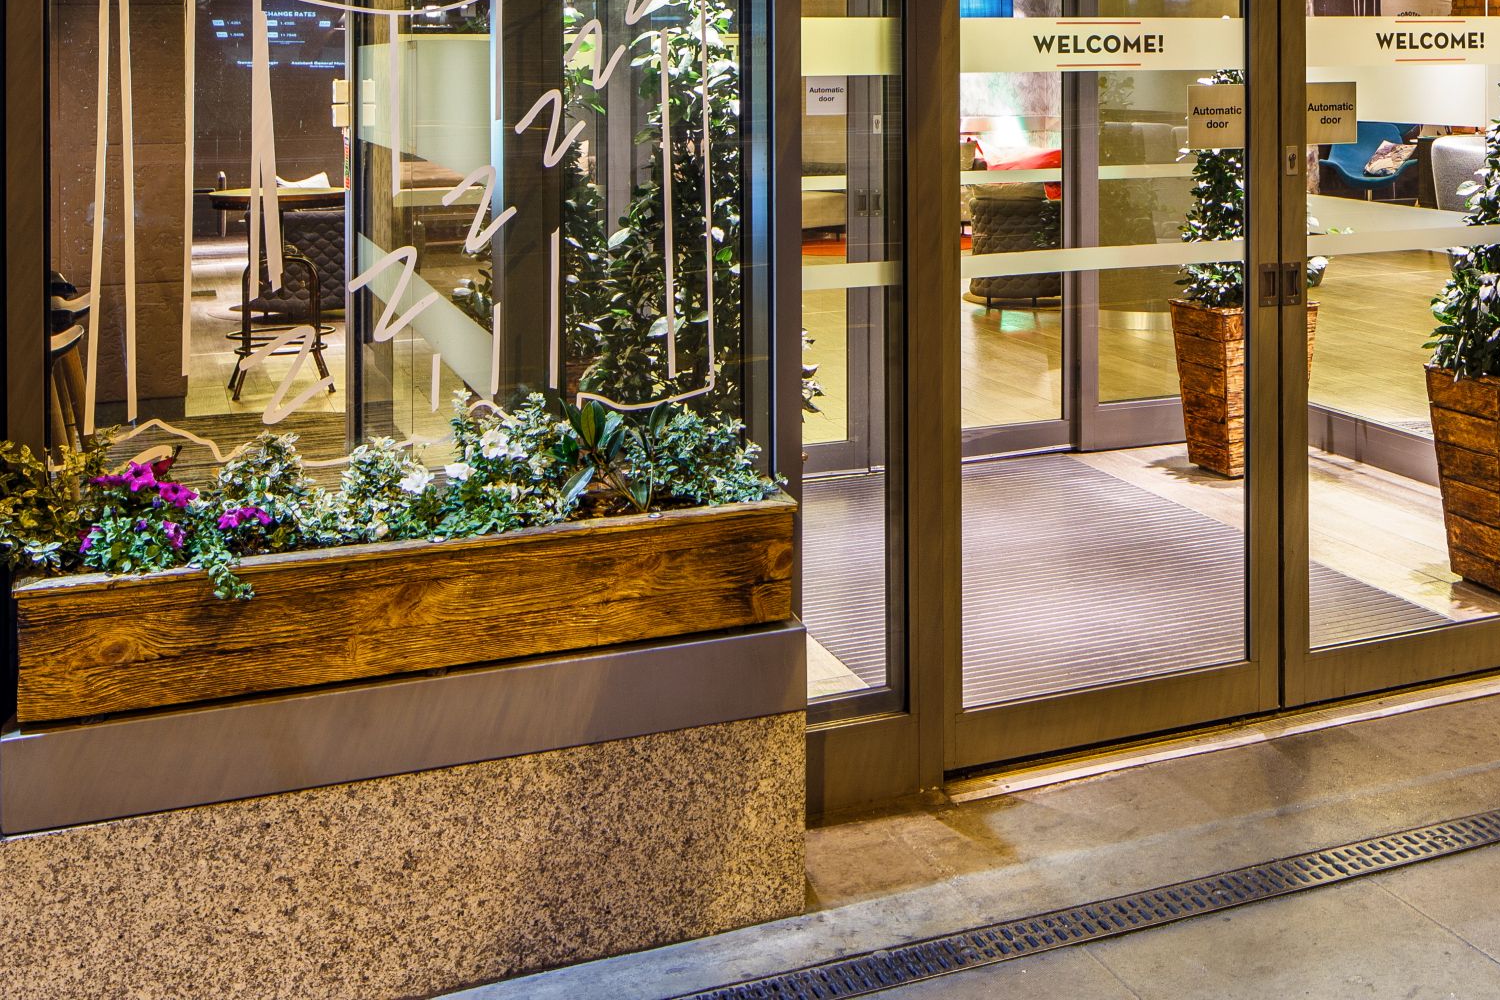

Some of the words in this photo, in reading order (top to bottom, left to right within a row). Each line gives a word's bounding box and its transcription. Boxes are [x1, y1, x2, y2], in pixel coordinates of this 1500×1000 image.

[1033, 34, 1165, 54] WELCOME!
[1376, 32, 1485, 50] WELCOME!
[809, 86, 844, 95] Automatic
[819, 95, 835, 103] door
[1192, 105, 1242, 117] Automatic
[1308, 102, 1354, 113] Automatic
[1206, 119, 1229, 129] door
[1320, 115, 1342, 125] door
